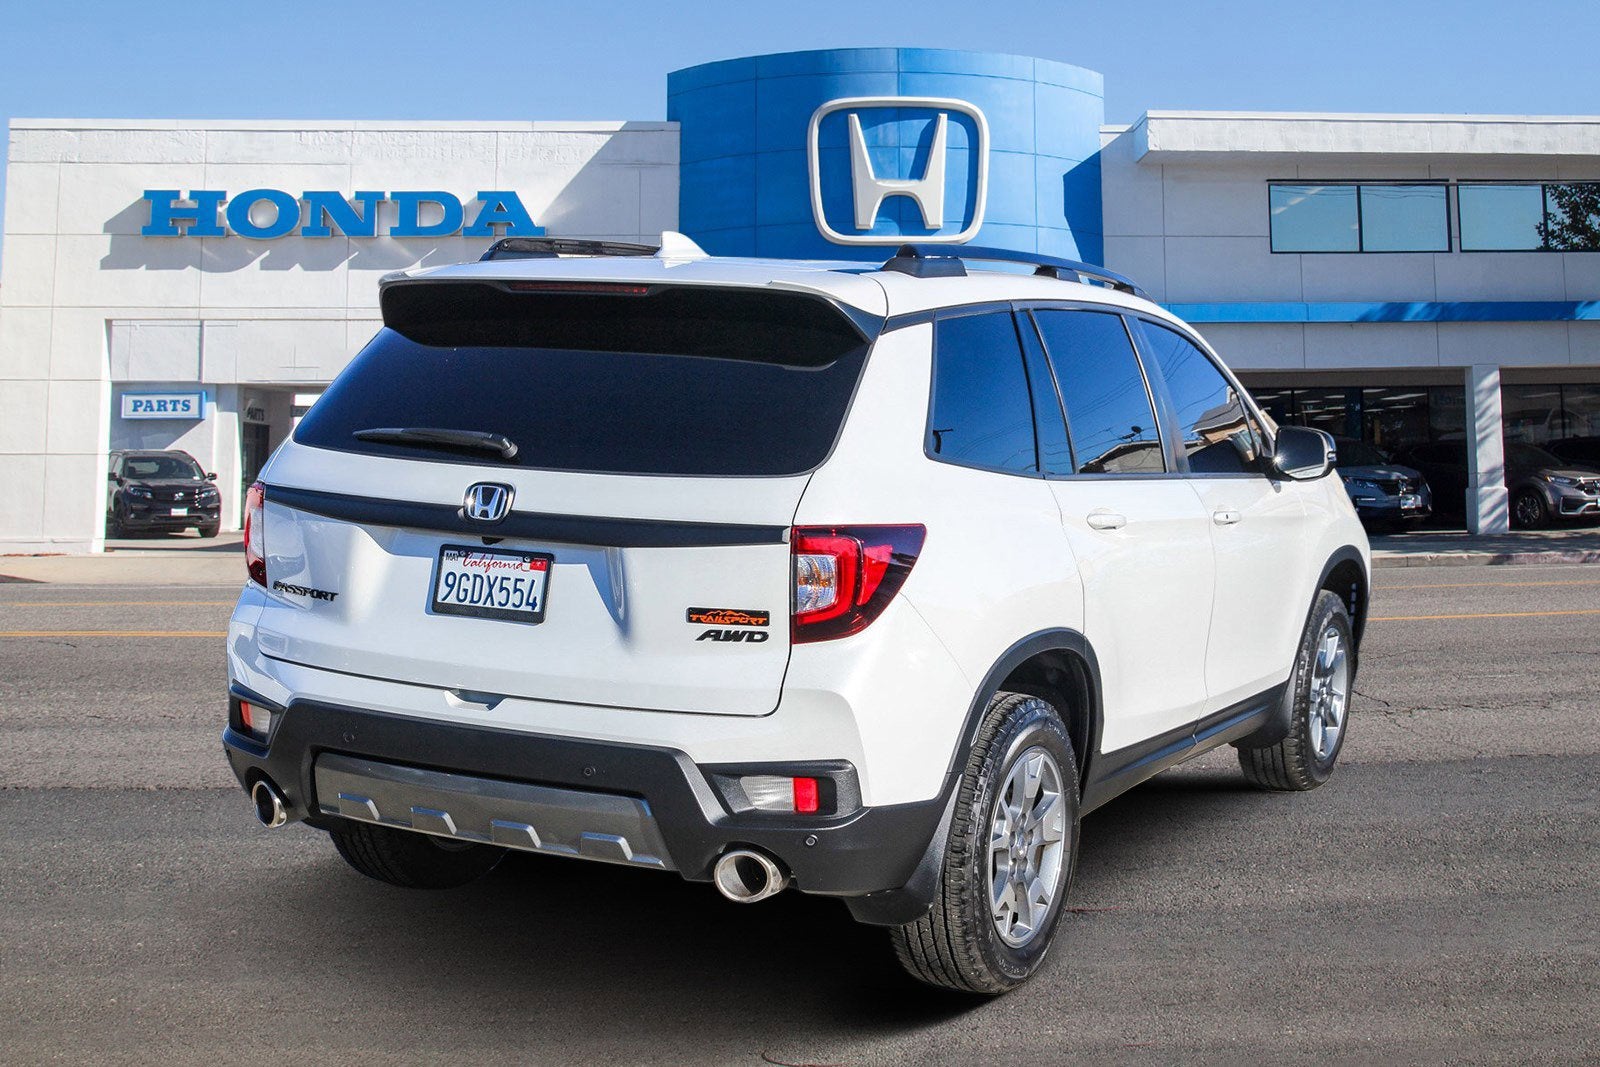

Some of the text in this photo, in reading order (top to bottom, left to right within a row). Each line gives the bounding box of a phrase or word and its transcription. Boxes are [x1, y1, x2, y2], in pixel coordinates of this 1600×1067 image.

[141, 188, 547, 240] HONDA
[132, 399, 191, 412] PARTS
[463, 552, 530, 573] California
[273, 580, 339, 601] PASSPORT
[441, 571, 538, 611] 9GDX554
[689, 614, 767, 626] TRAILSPORT
[695, 629, 769, 643] AWD
